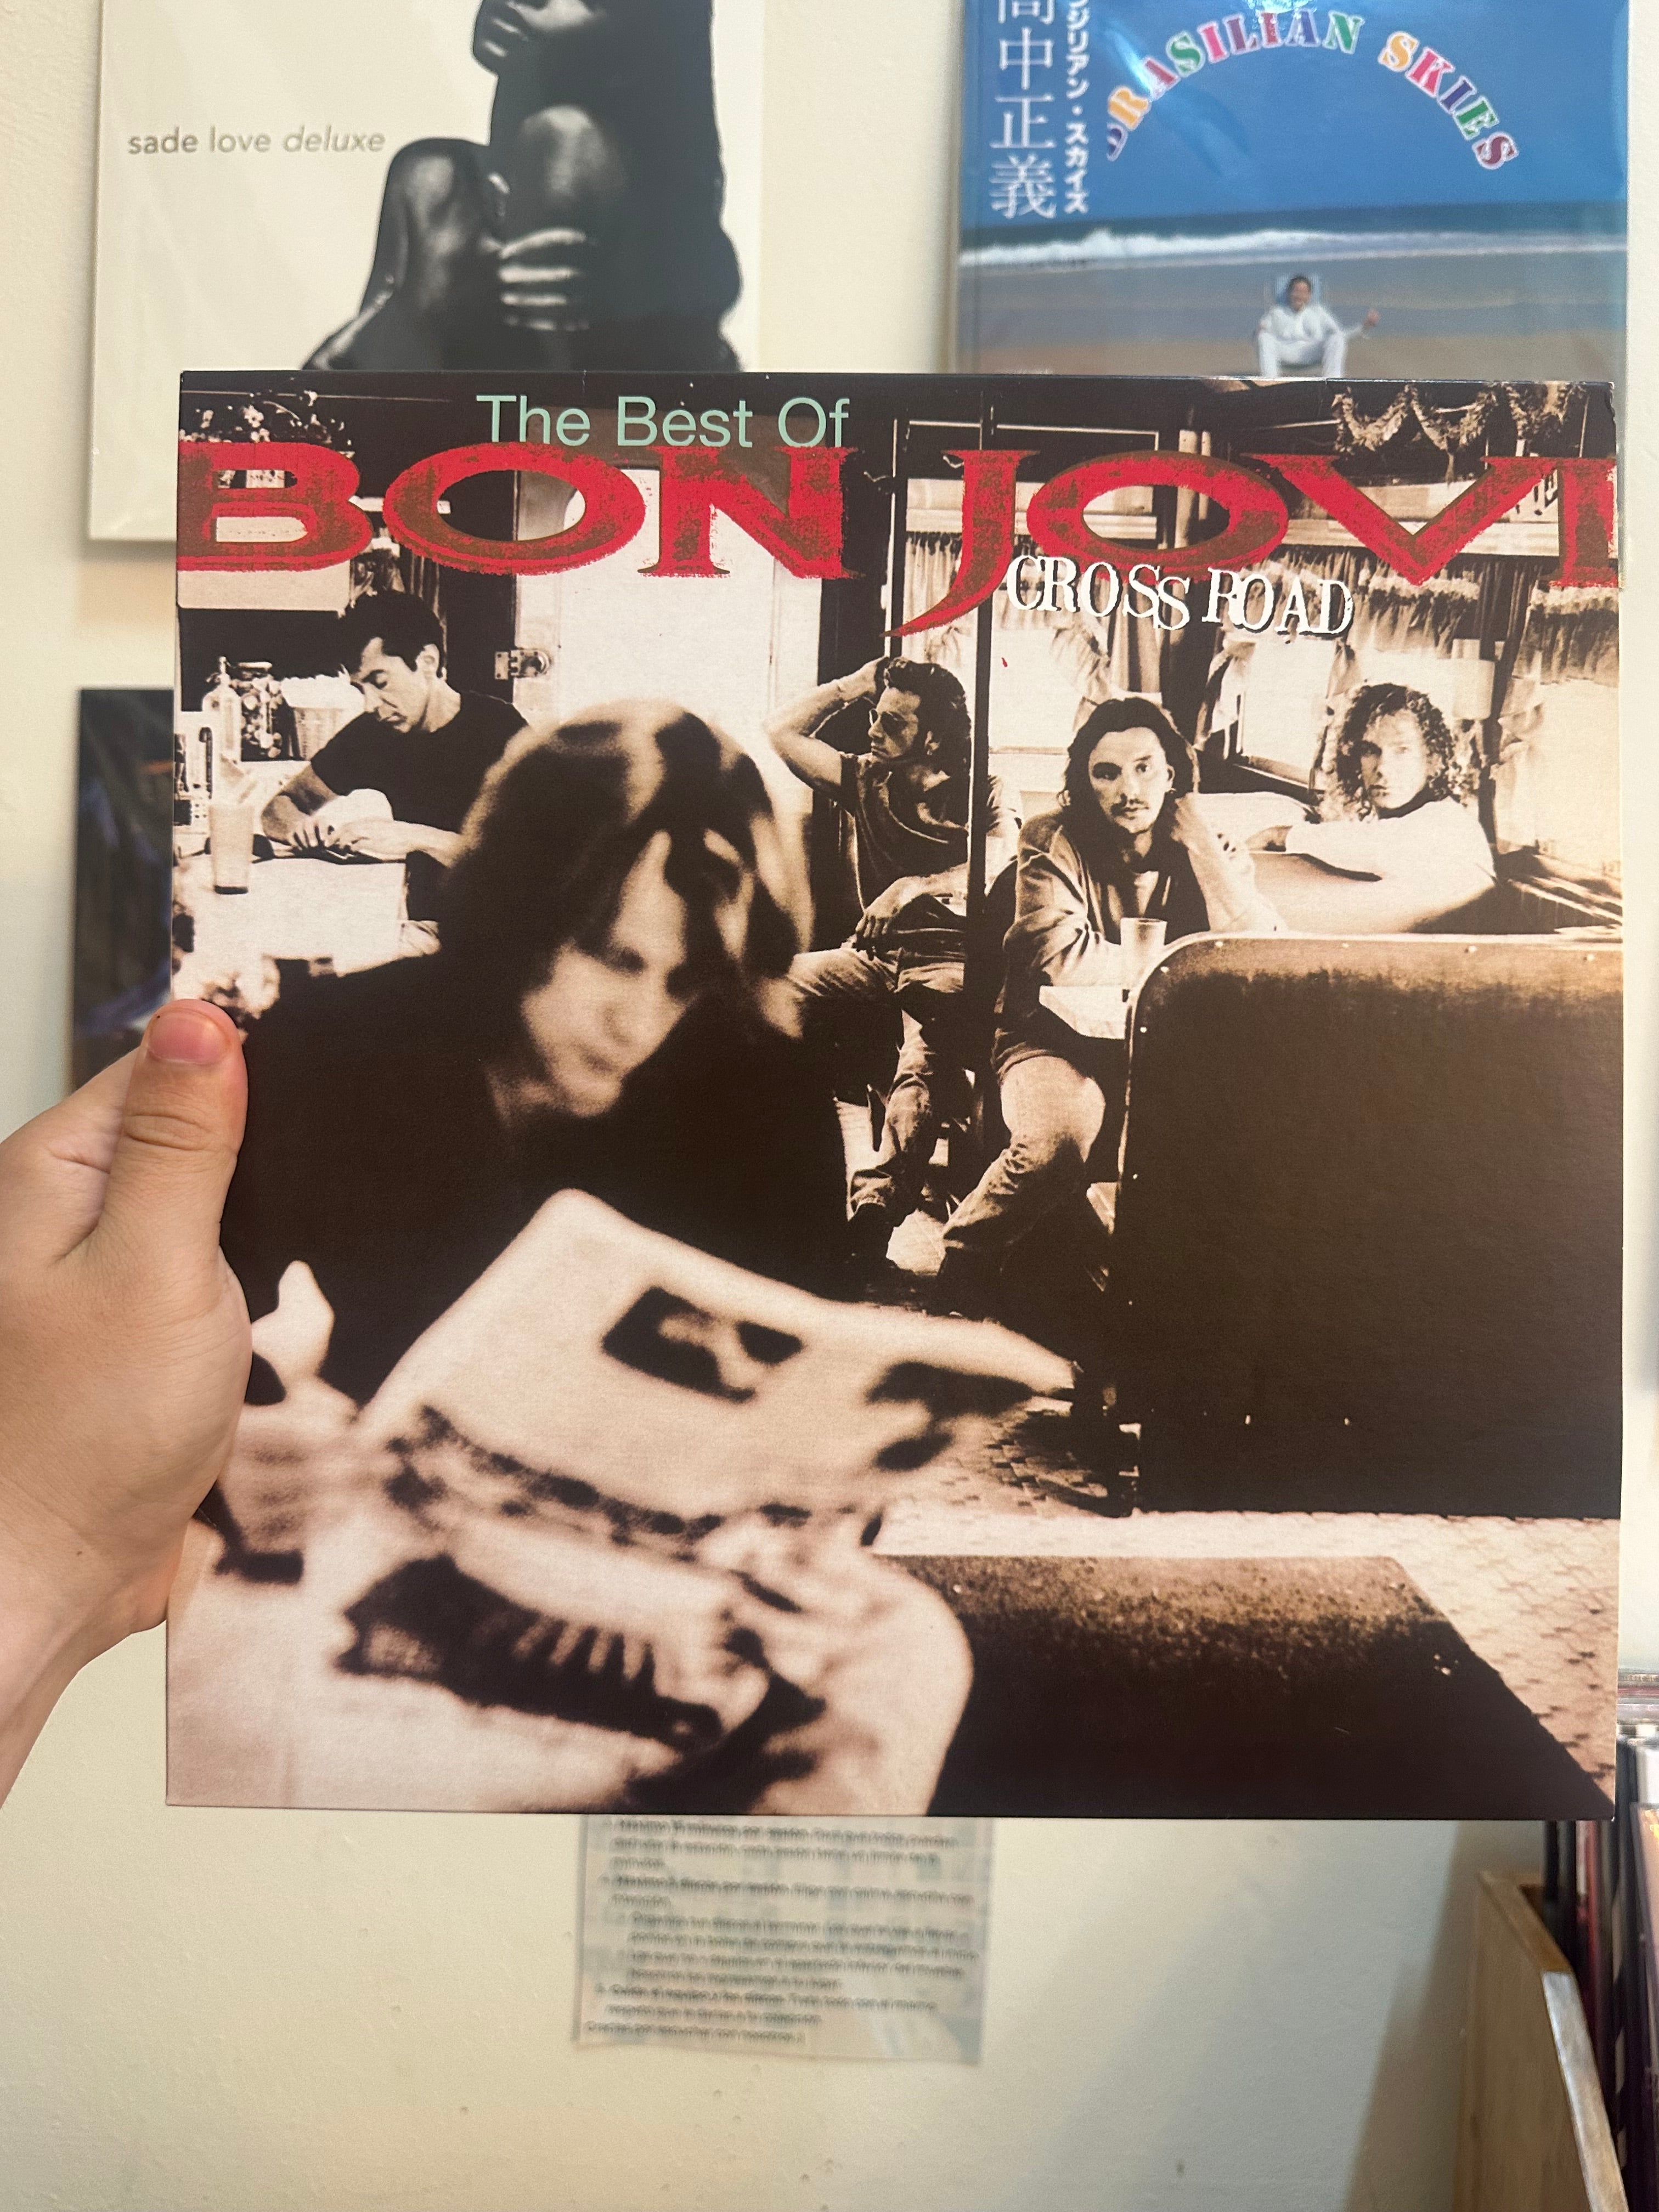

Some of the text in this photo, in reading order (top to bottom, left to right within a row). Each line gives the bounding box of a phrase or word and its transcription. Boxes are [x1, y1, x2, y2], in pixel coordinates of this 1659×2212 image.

[127, 125, 386, 155] sade love deluxe
[1378, 31, 1519, 170] SKIES
[476, 394, 850, 448] The Best Of
[177, 441, 1618, 637] BON JOVI
[1006, 555, 1354, 636] CROSS ROAD
